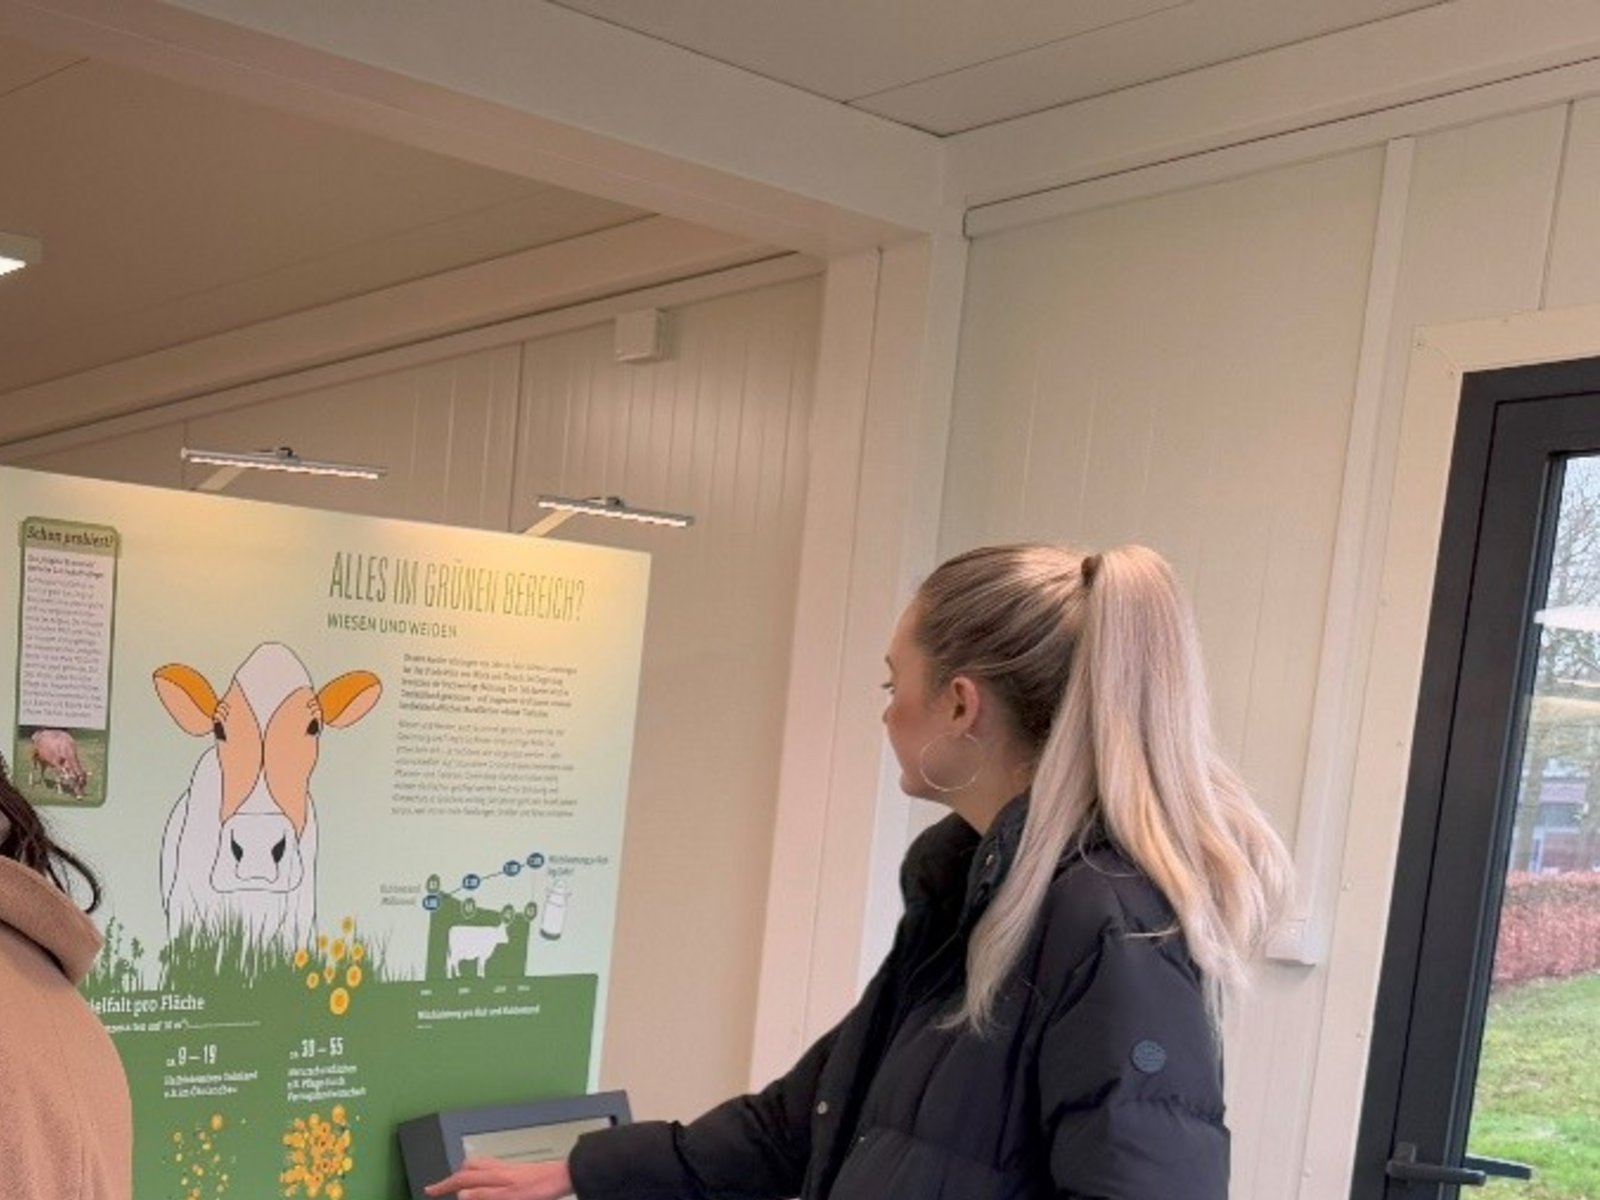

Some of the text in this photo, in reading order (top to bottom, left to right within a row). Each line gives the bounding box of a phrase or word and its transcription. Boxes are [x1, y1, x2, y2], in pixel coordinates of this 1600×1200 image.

[329, 551, 585, 622] ALLES IM GRÜNEN BEREICH?
[327, 613, 457, 638] WIESEN UND WEIDEN
[90, 996, 131, 1014] ielfalt
[161, 994, 205, 1011] Fläche
